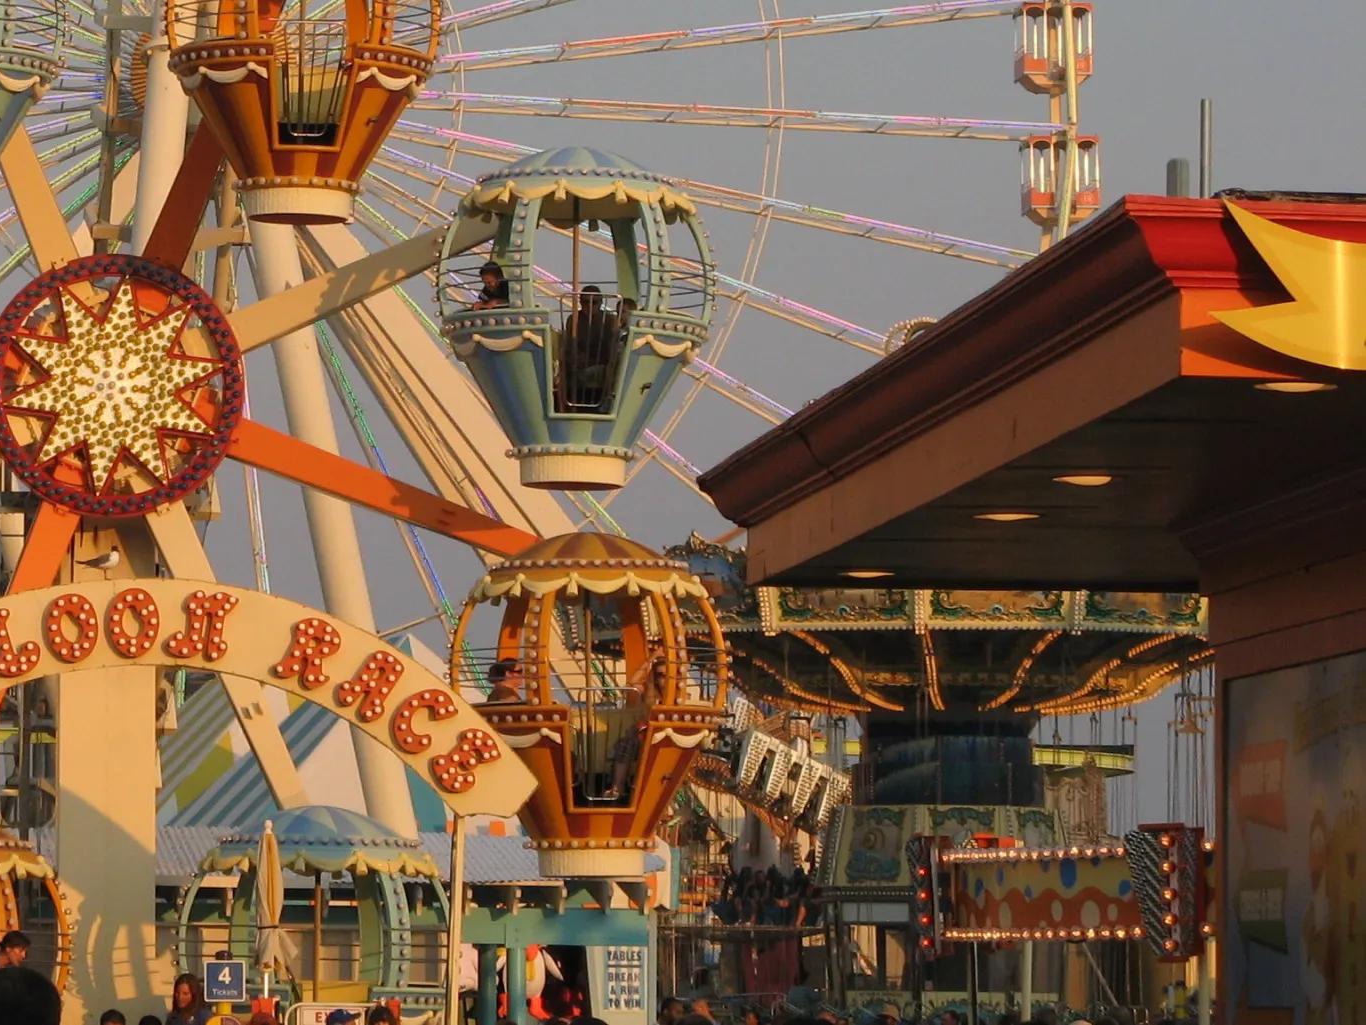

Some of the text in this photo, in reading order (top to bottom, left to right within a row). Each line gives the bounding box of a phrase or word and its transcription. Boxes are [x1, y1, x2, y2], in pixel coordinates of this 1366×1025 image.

[273, 616, 502, 794] RACE
[607, 951, 642, 961] TABLES
[217, 966, 232, 985] 4
[211, 988, 239, 996] Tickets
[608, 998, 642, 1008] TO WIN
